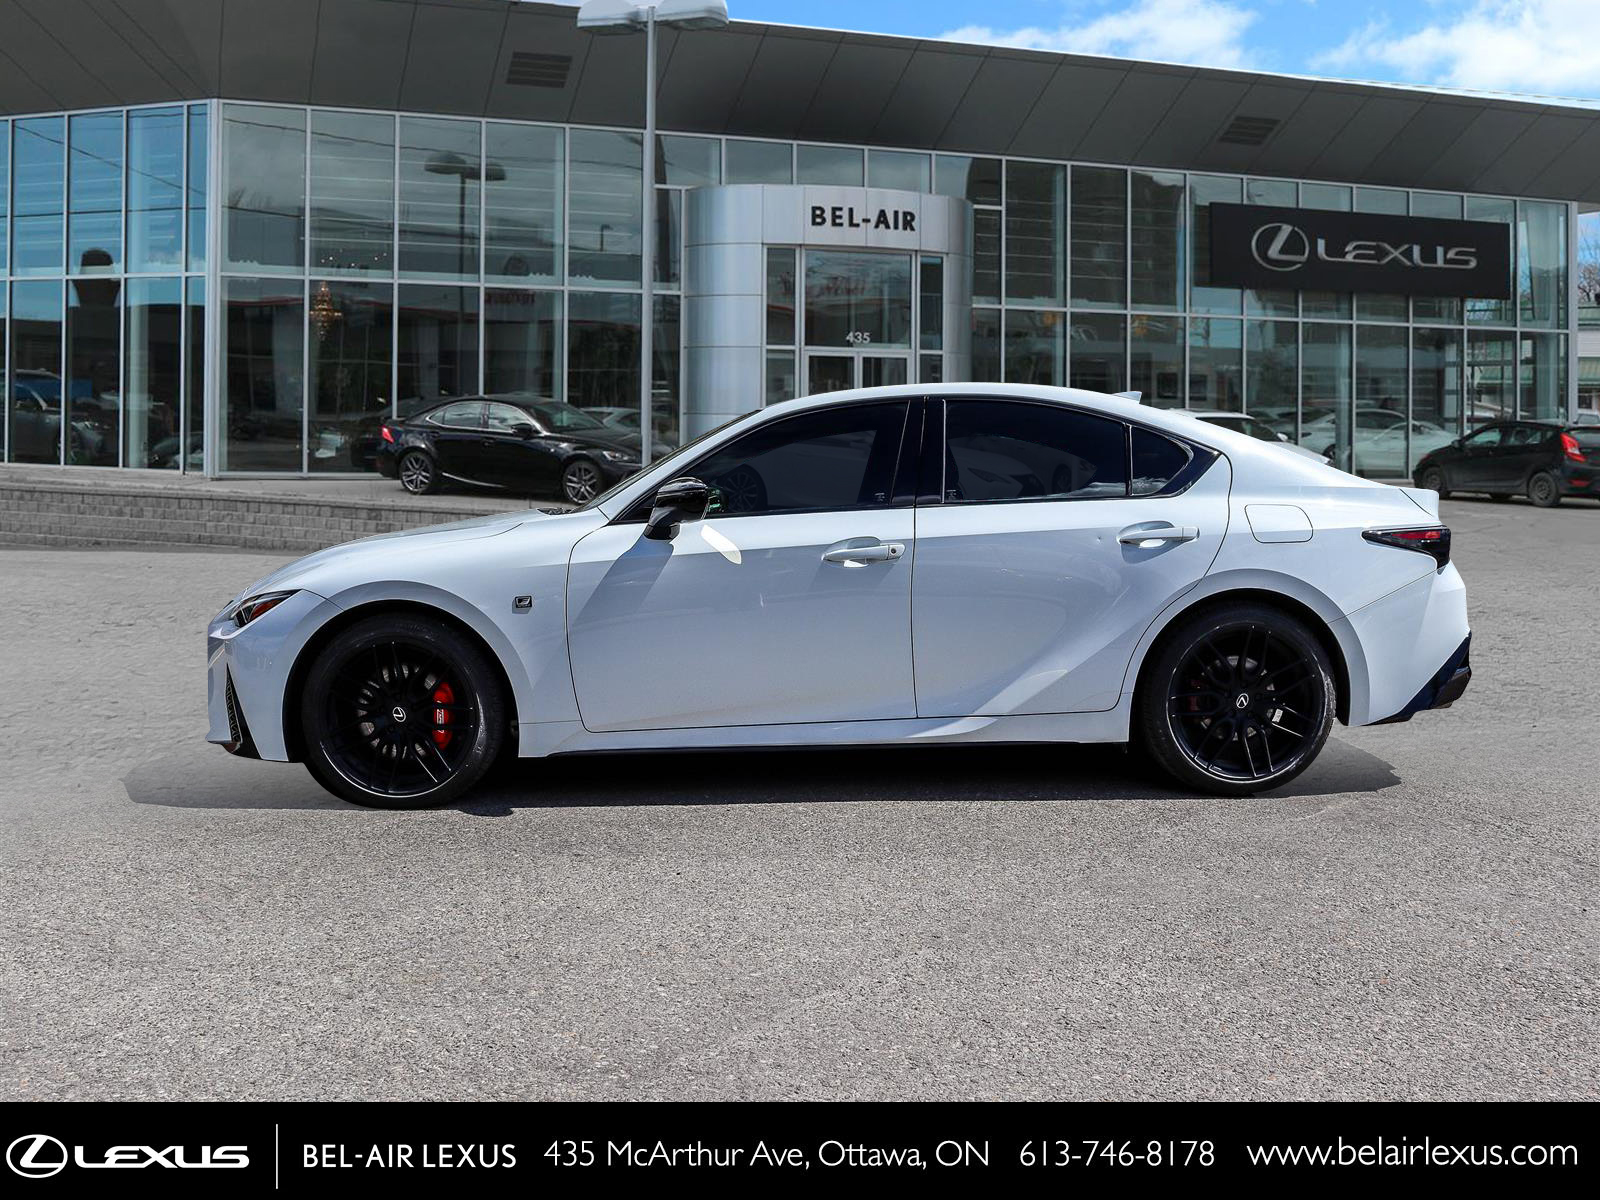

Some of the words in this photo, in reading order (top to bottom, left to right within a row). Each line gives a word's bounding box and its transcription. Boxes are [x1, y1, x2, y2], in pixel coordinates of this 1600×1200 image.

[811, 206, 916, 232] BEL-AIR
[1316, 237, 1478, 270] LEXUS
[845, 331, 871, 344] 435
